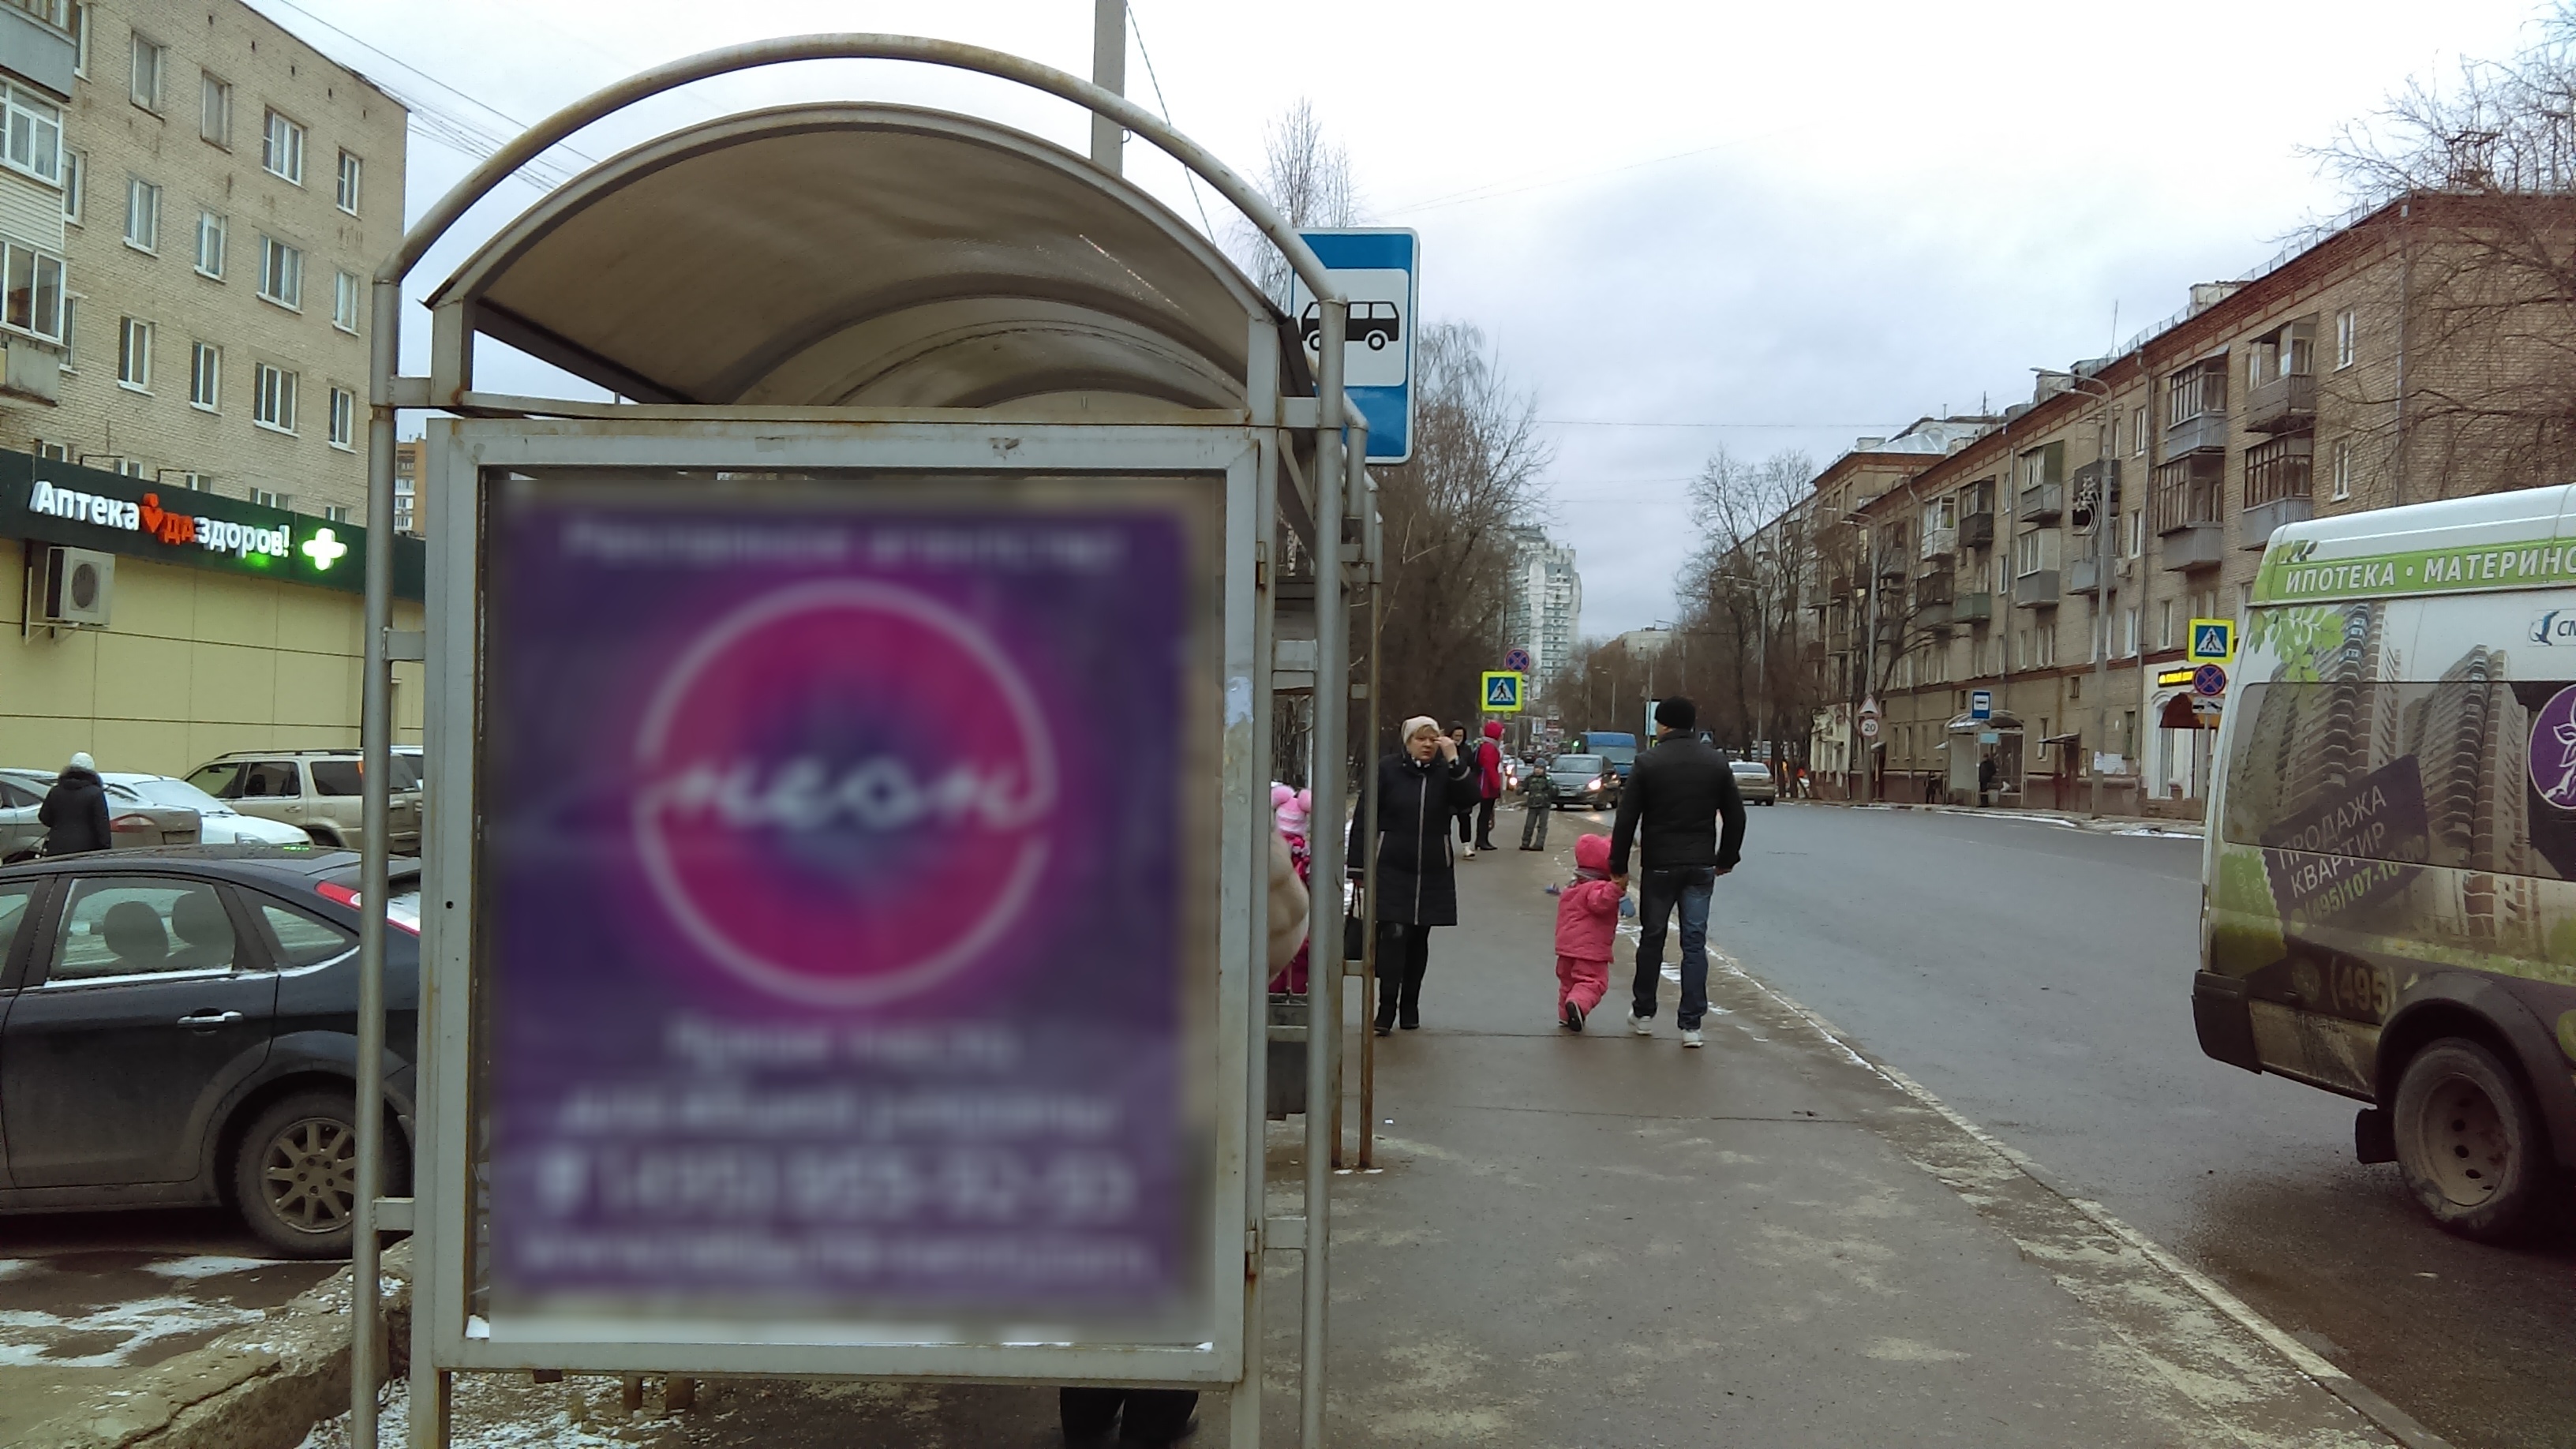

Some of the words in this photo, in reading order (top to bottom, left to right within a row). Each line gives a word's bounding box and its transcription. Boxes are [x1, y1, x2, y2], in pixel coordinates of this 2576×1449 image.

[29, 481, 140, 531] Аптека
[2285, 561, 2394, 594] ИПОТЕКА
[1864, 723, 1876, 732] 20
[2278, 784, 2387, 870] ПРОДАЖА
[2290, 821, 2385, 899] КВАРТИР
[2331, 954, 2397, 1016] (495)
